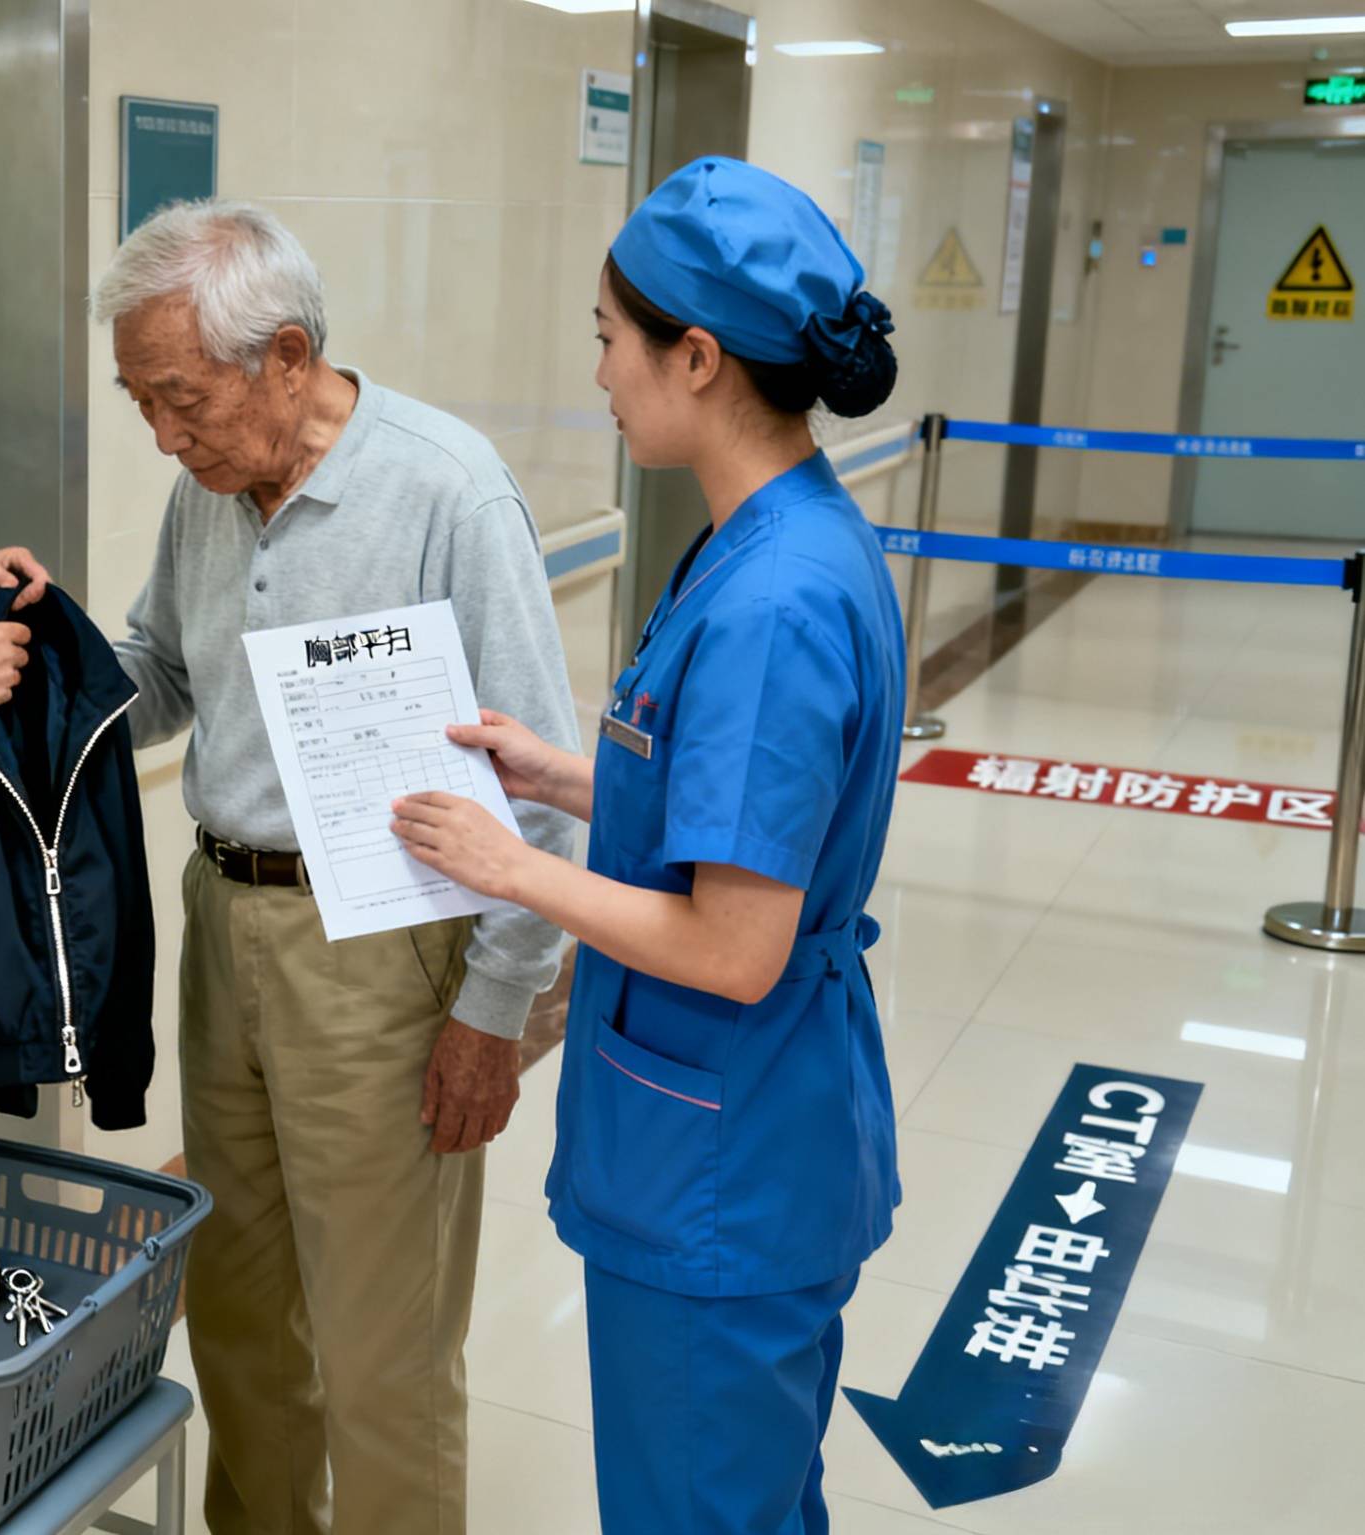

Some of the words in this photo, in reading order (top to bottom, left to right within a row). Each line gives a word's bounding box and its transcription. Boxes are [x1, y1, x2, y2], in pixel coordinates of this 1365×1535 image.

[967, 754, 1334, 826] 辐射防护区
